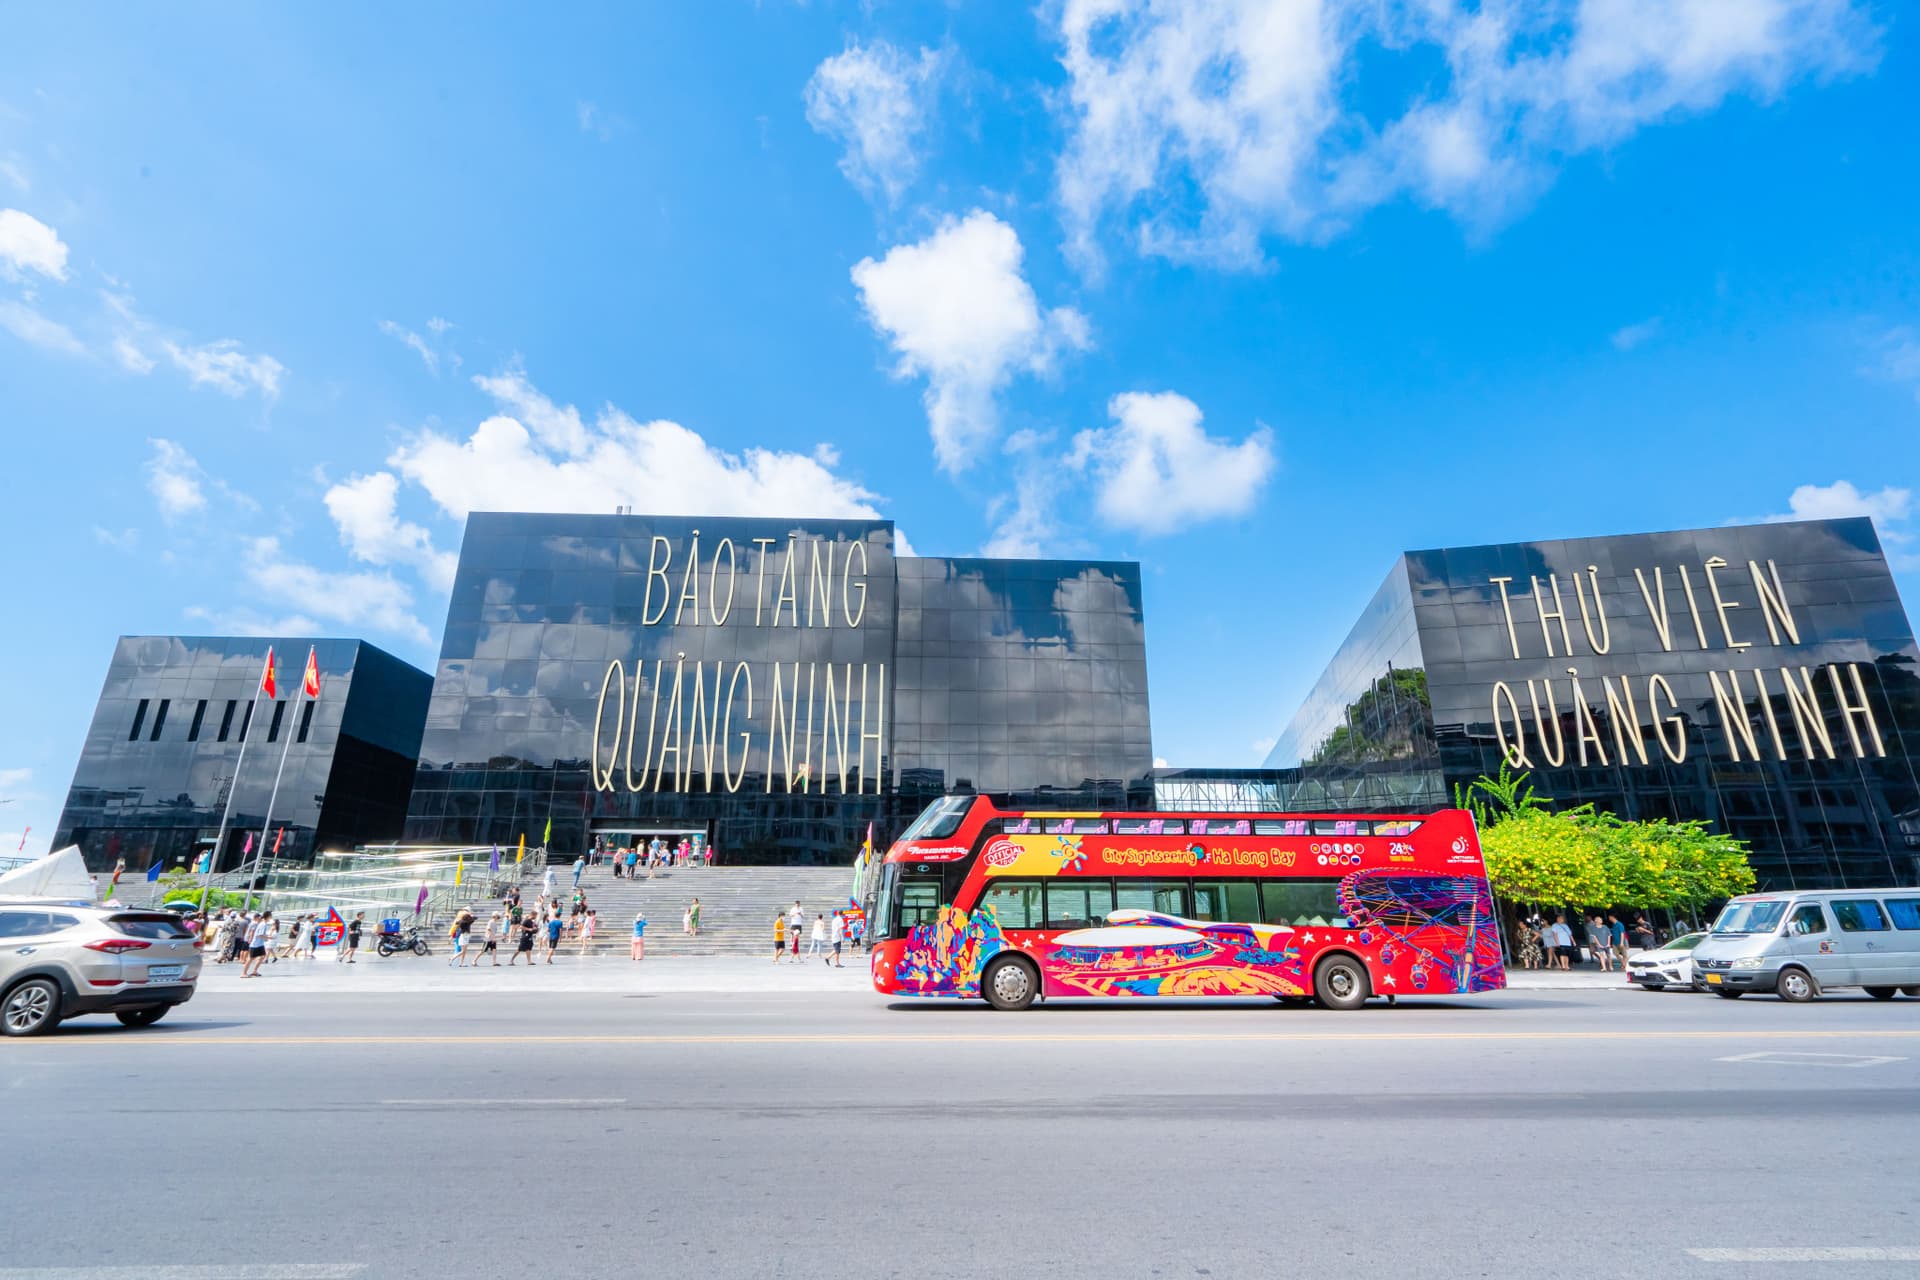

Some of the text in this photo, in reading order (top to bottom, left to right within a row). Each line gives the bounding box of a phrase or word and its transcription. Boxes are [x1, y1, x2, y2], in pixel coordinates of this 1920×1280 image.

[642, 529, 867, 628] BẢO TÀNG
[1633, 555, 1801, 653] VIỆN
[592, 652, 884, 795] QUẢNG NINH
[1491, 663, 1887, 769] QUẢNG NINH
[987, 846, 1022, 863] OFFICIAL
[1233, 848, 1268, 868] Long
[1270, 848, 1296, 867] Bay
